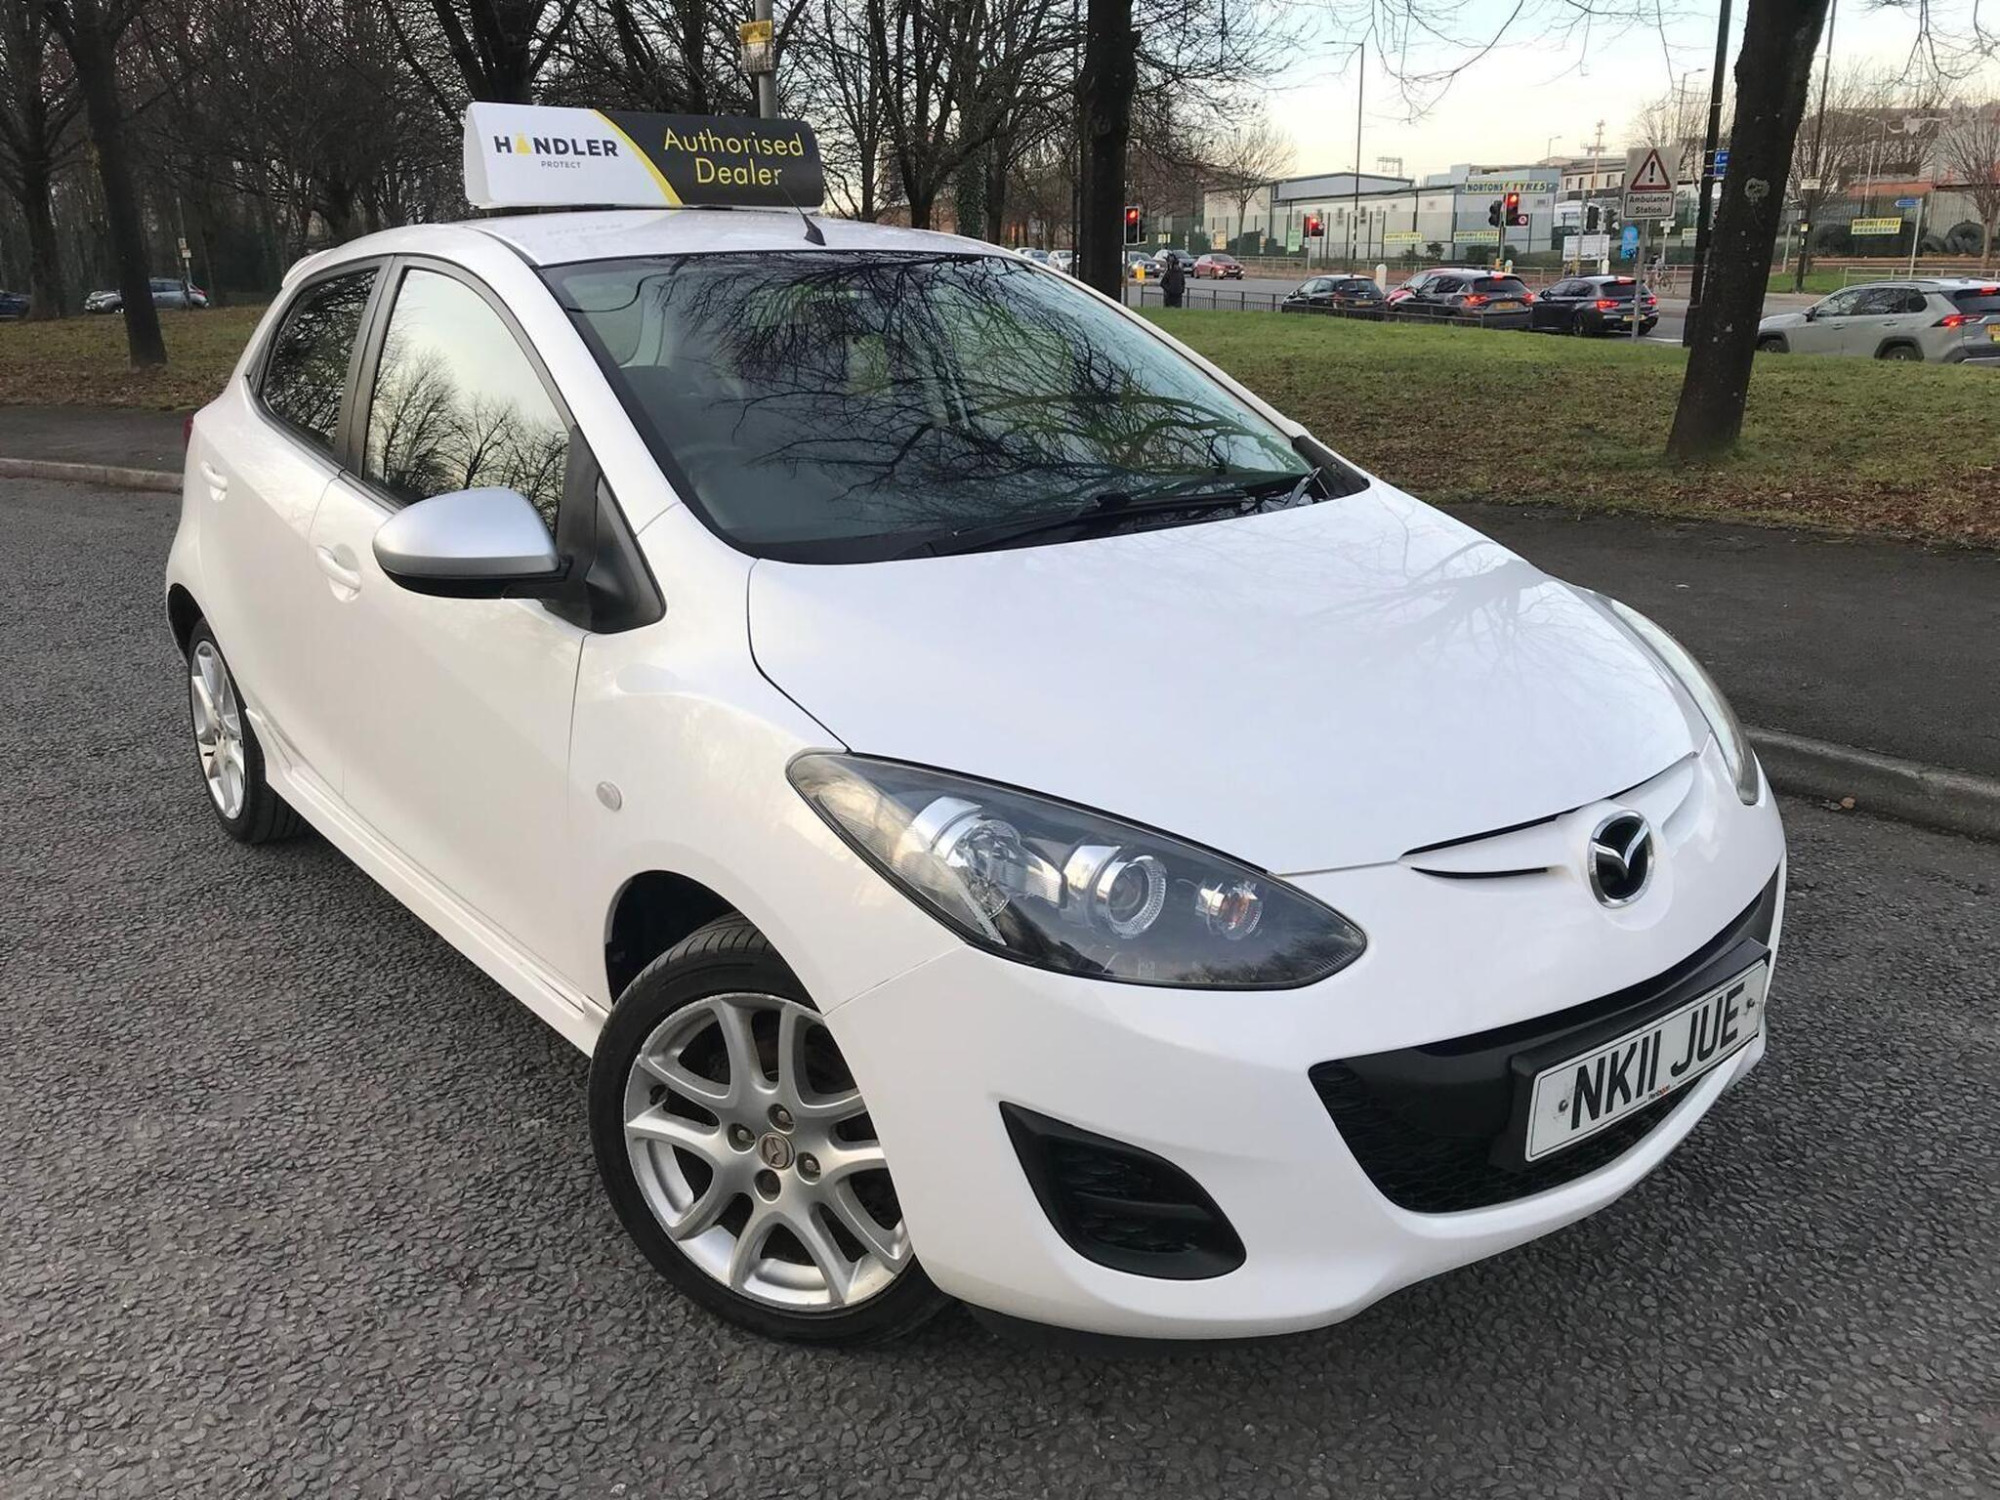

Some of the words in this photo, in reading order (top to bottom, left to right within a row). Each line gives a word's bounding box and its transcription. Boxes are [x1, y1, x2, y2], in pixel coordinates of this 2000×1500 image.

[663, 127, 804, 156] Authorised
[540, 160, 581, 169] PROTECT
[694, 157, 782, 185] Dealer
[1629, 195, 1670, 203] Ambulance
[1635, 205, 1662, 214] Station
[1670, 981, 1746, 1078] JUE
